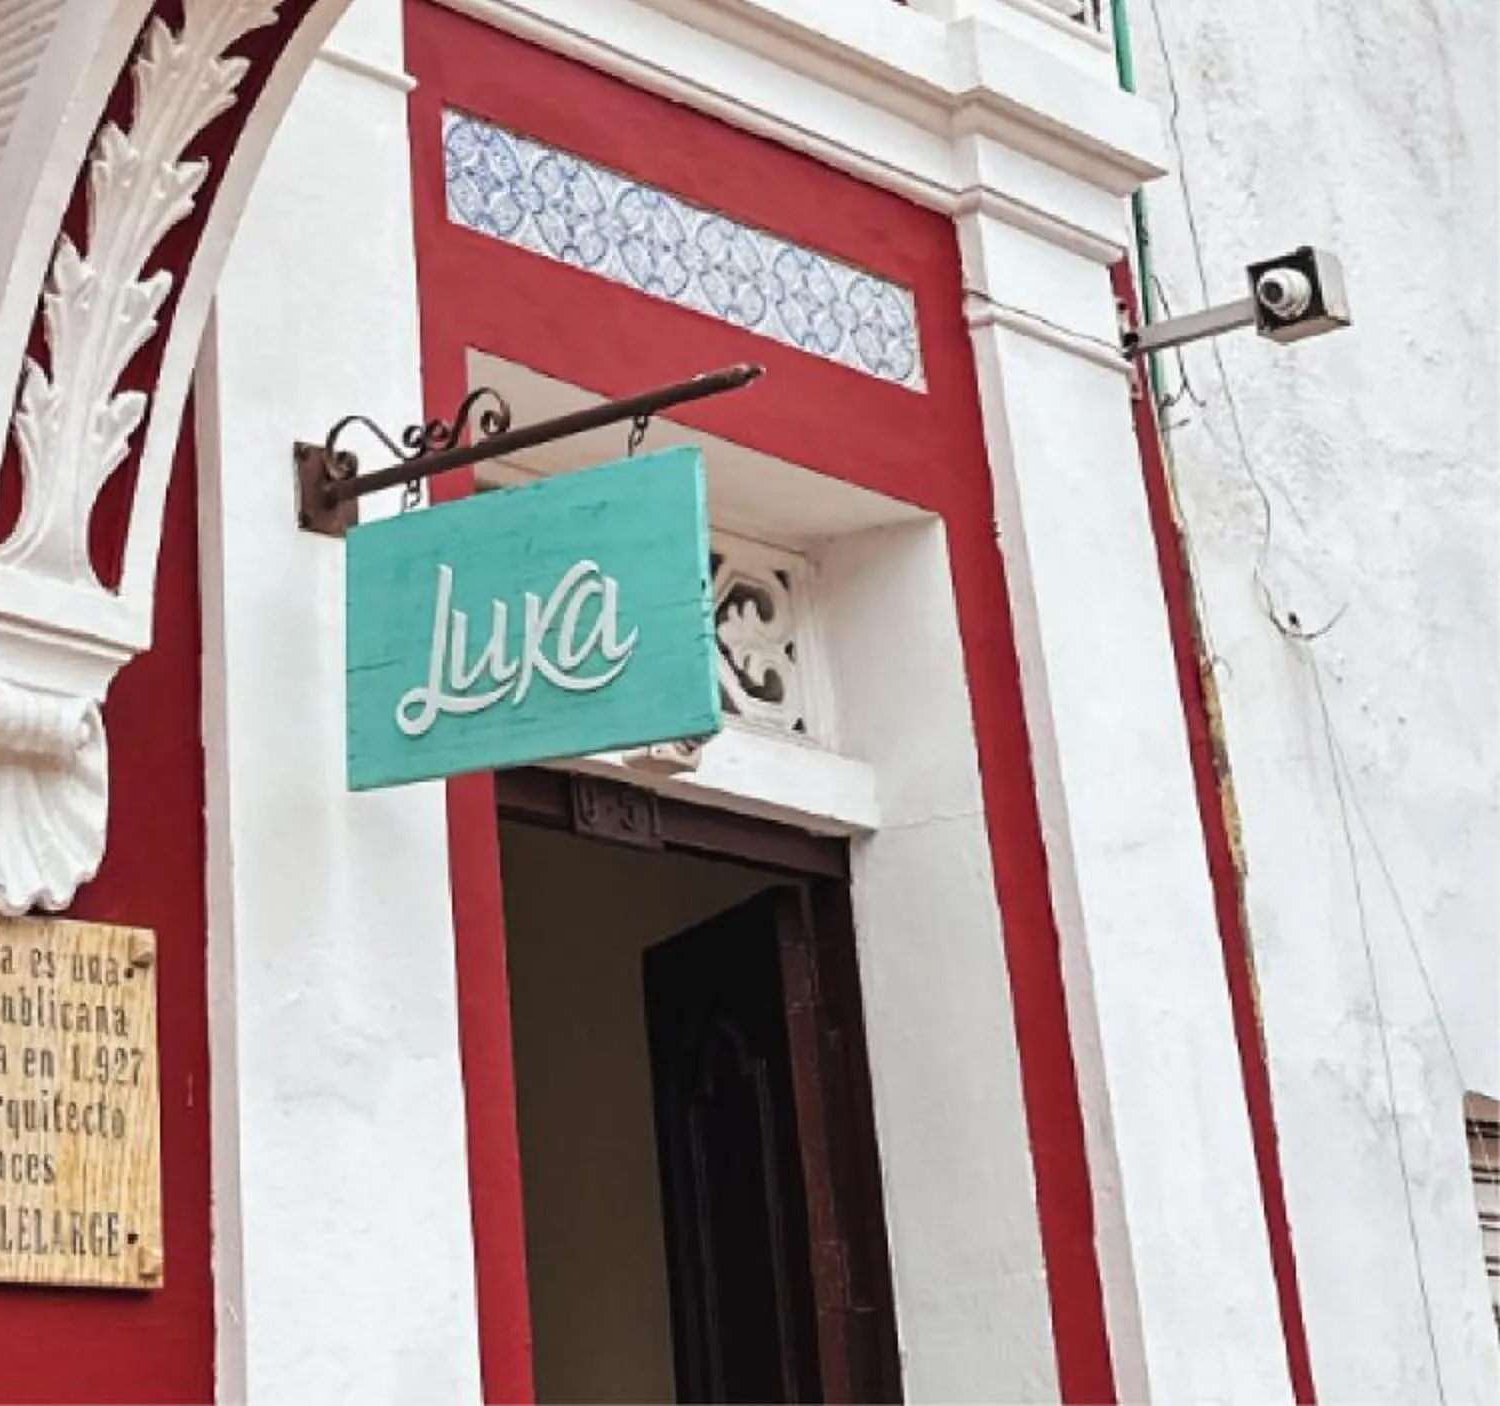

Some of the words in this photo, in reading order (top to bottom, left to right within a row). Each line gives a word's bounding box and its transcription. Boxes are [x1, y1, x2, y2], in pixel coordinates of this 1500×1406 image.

[395, 559, 639, 735] Luka
[30, 947, 56, 980] es
[72, 952, 120, 988] una
[24, 1047, 56, 1079] en
[72, 1043, 145, 1087] 1.927
